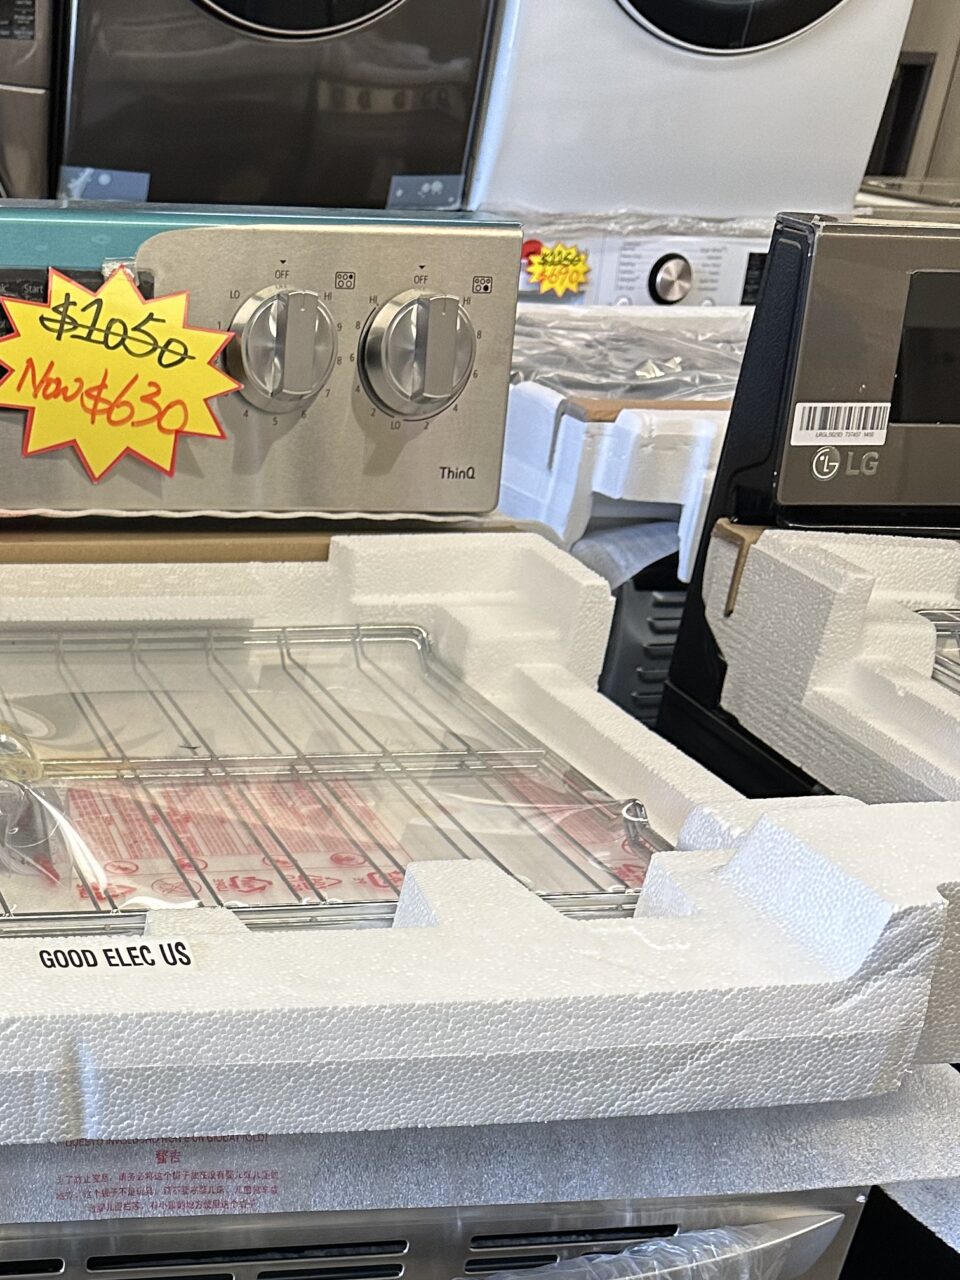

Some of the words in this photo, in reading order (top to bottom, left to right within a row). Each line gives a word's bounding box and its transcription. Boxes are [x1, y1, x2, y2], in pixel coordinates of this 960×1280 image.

[275, 270, 289, 279] OFF
[414, 275, 428, 284] OFF
[230, 291, 240, 299] LO
[324, 292, 333, 301] HI
[369, 296, 378, 305] HI
[463, 297, 471, 306] HI
[217, 321, 222, 329] 1
[337, 323, 342, 331] 9
[355, 321, 361, 329] 8
[39, 293, 196, 369] $1050
[476, 330, 482, 339] 8
[349, 354, 355, 362] 6
[473, 370, 478, 378] 6
[325, 389, 331, 397] 7
[354, 385, 360, 393] 4
[16, 357, 84, 401] Now
[80, 368, 189, 435] $630
[371, 408, 376, 417] 2
[452, 404, 458, 412] 4
[243, 410, 248, 418] 4
[272, 417, 278, 426] 5
[391, 421, 401, 430] LO
[424, 421, 429, 430] 2
[846, 451, 879, 476] LG
[440, 467, 476, 480] ThinQ
[39, 949, 98, 968] GOOD
[102, 945, 155, 967] ELEC
[159, 942, 191, 966] US
